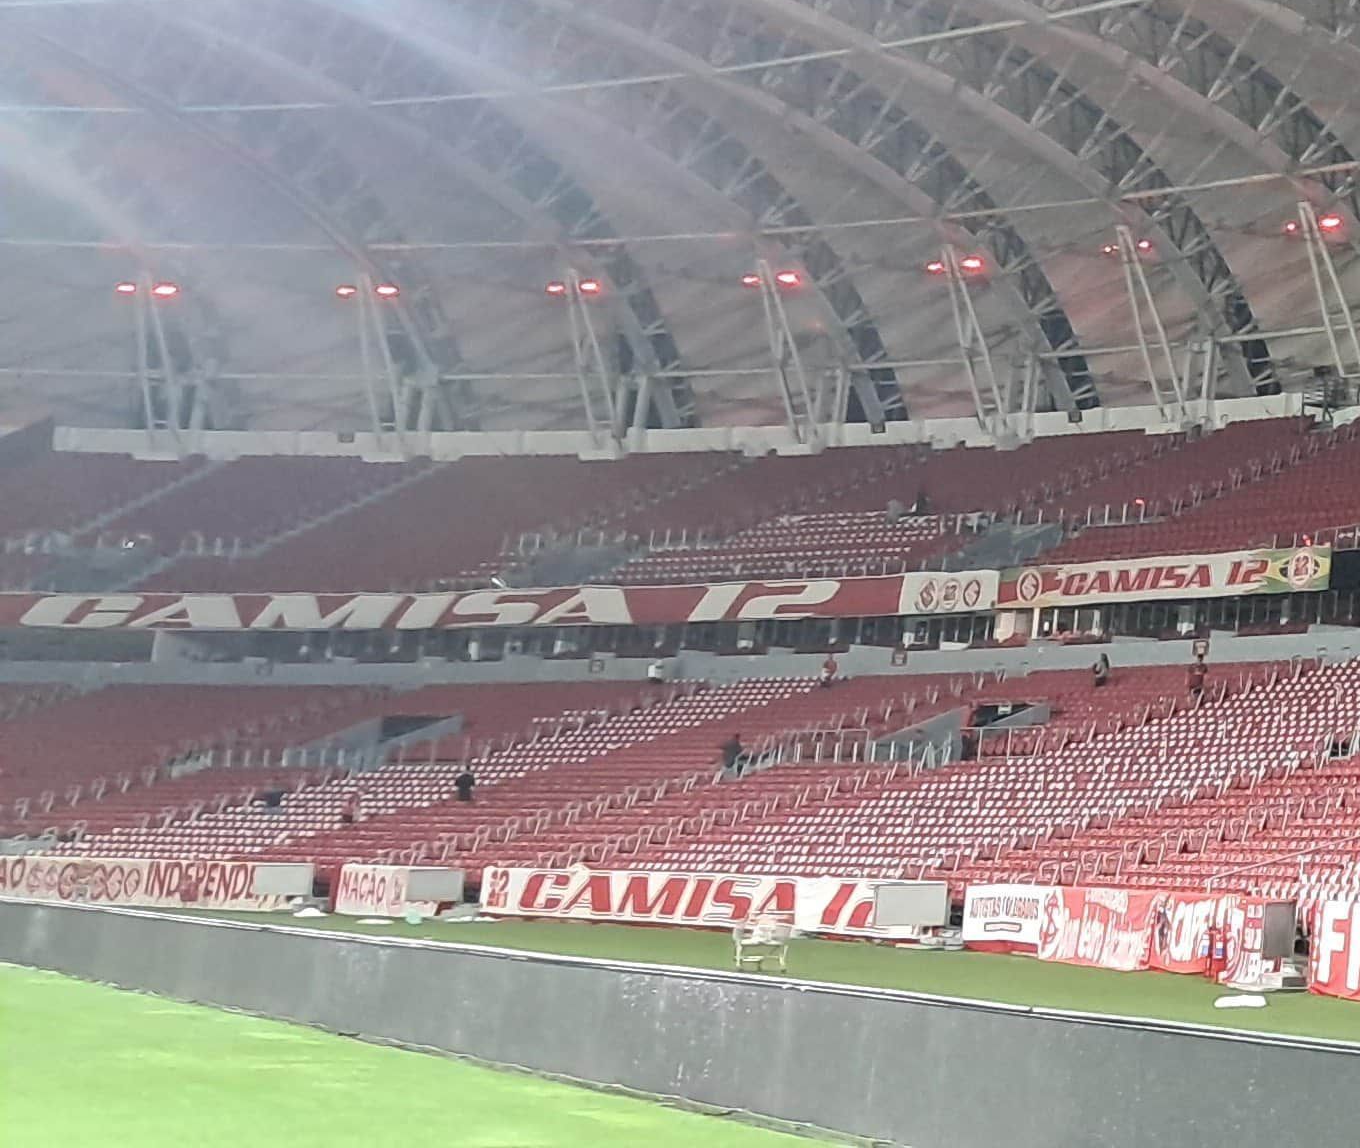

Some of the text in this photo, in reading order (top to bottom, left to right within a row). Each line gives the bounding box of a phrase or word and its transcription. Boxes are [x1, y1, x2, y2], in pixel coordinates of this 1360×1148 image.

[1061, 558, 1270, 596] CAMISA 12
[19, 580, 841, 629] CAMISA 12
[518, 870, 796, 926] CAMISA
